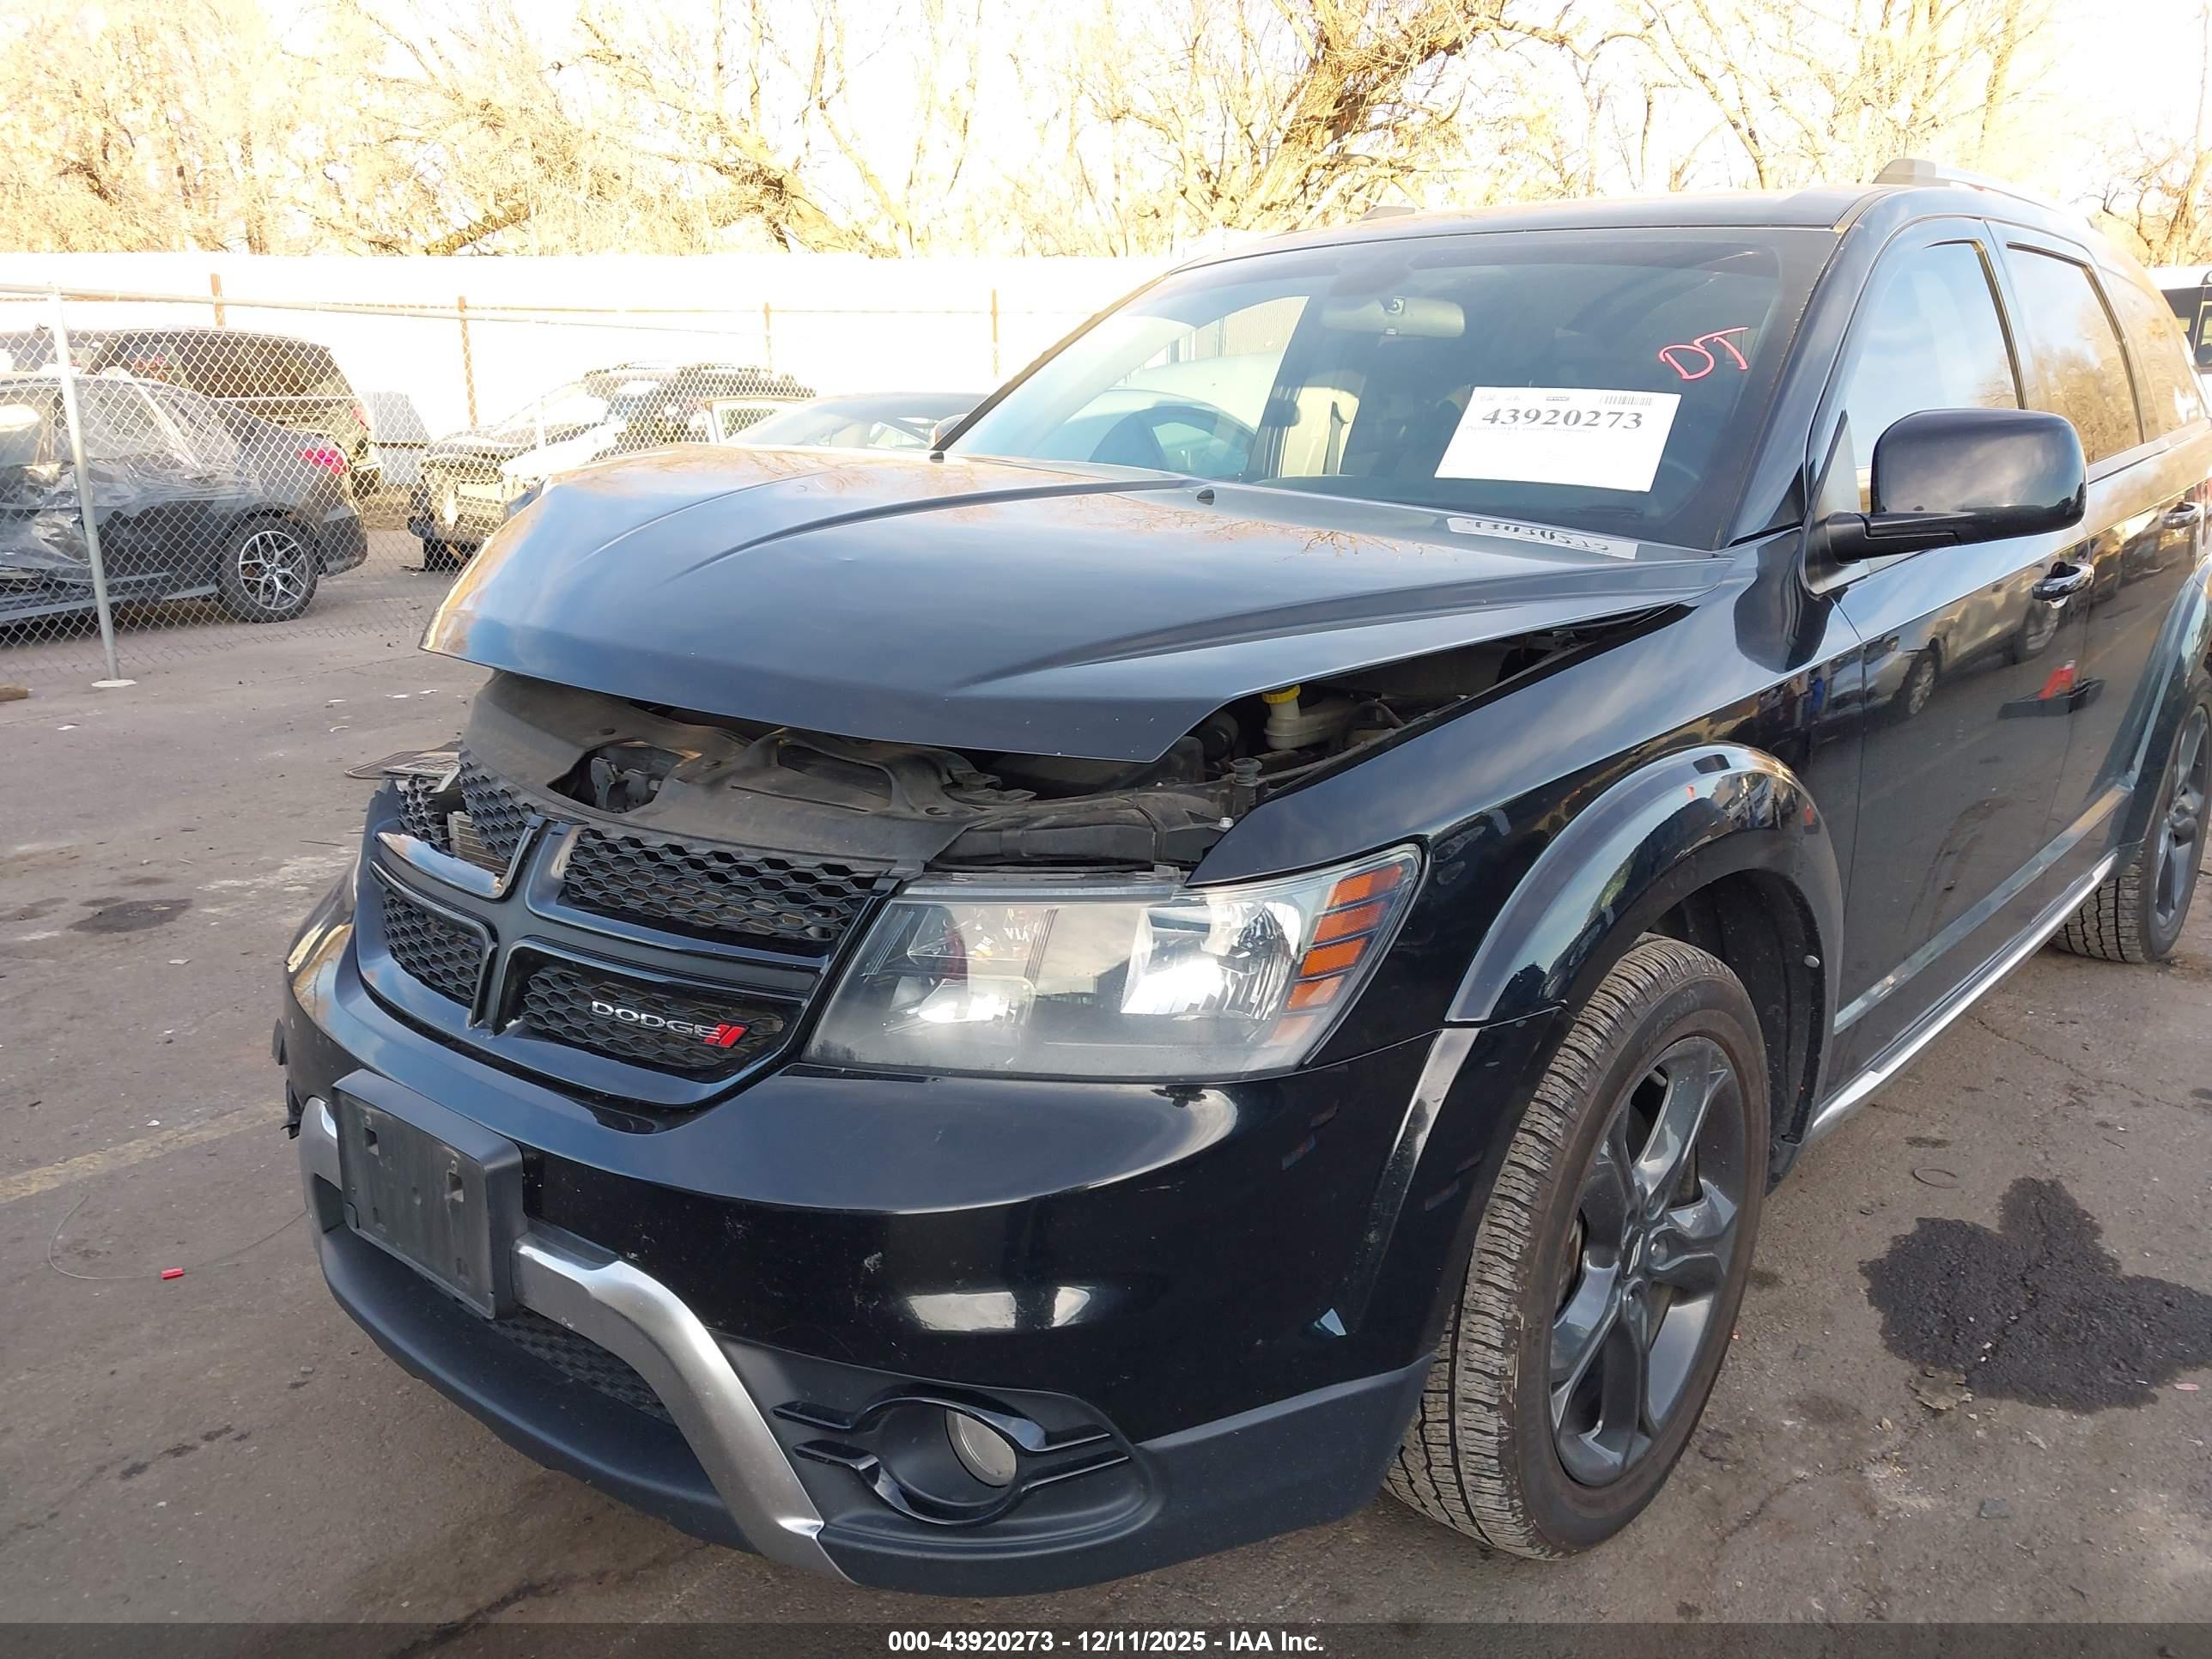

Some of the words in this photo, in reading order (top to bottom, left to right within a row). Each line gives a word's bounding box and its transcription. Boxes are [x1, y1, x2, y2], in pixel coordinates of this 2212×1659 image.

[1659, 326, 1749, 380] DT
[1482, 408, 1643, 429] 43920273
[591, 1000, 721, 1040] DODGE
